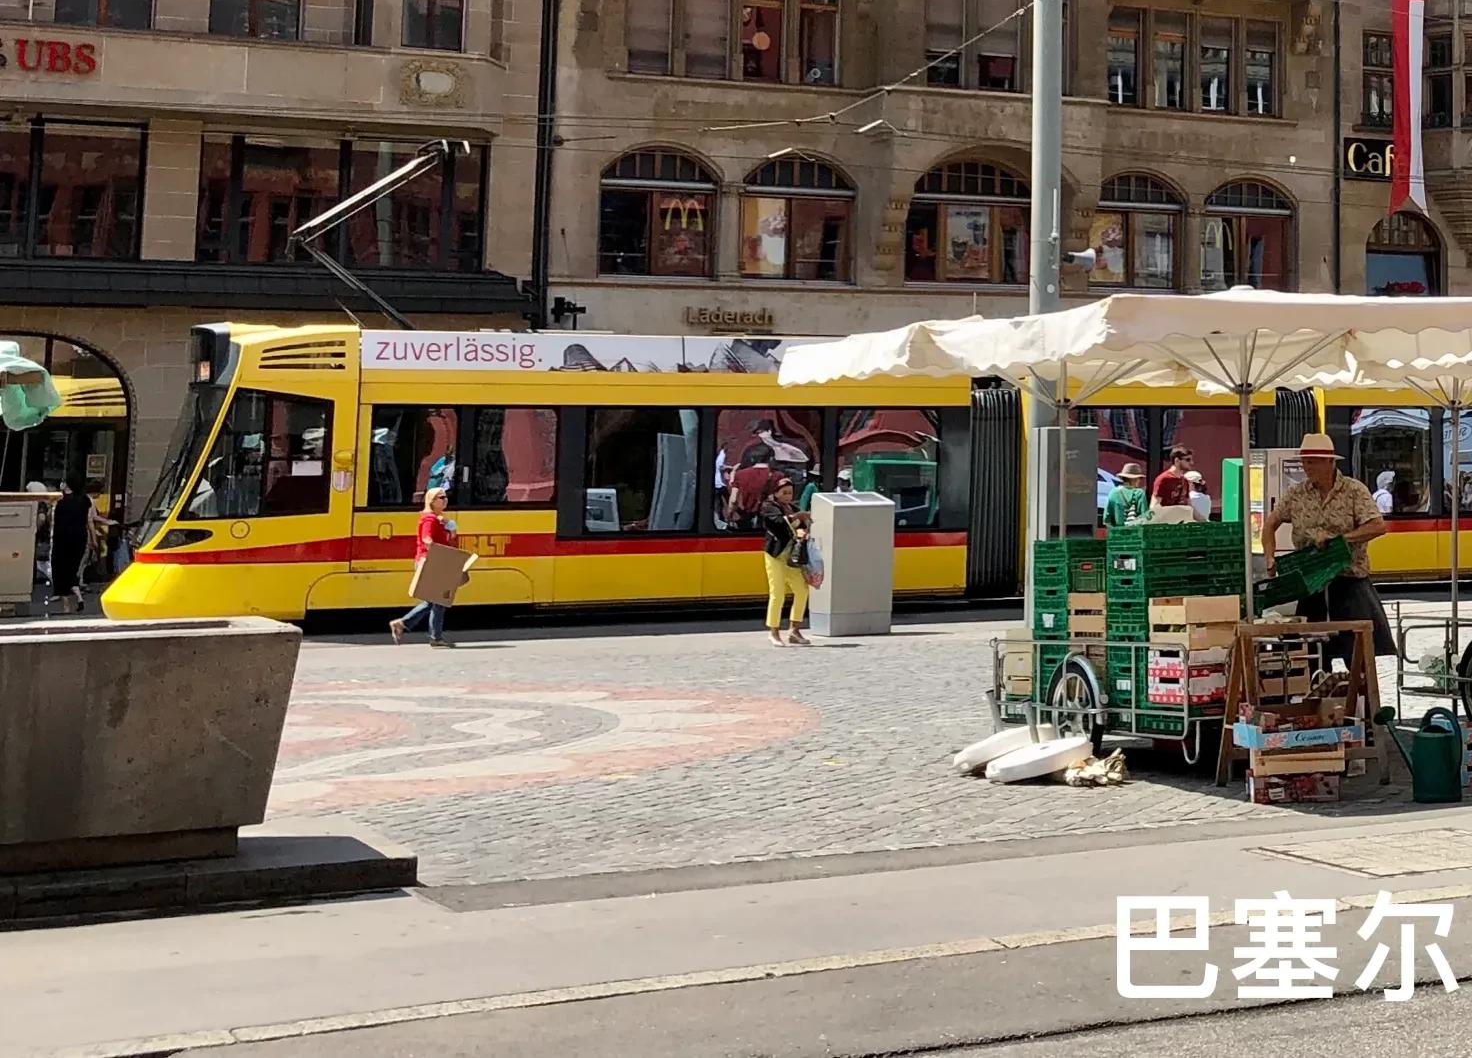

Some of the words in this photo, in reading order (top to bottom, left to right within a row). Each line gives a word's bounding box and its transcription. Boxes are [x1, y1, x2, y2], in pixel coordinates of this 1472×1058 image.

[15, 38, 96, 74] UBS
[1347, 142, 1394, 177] Caf
[685, 306, 773, 326] Läderach
[375, 336, 543, 368] zuverlässig.
